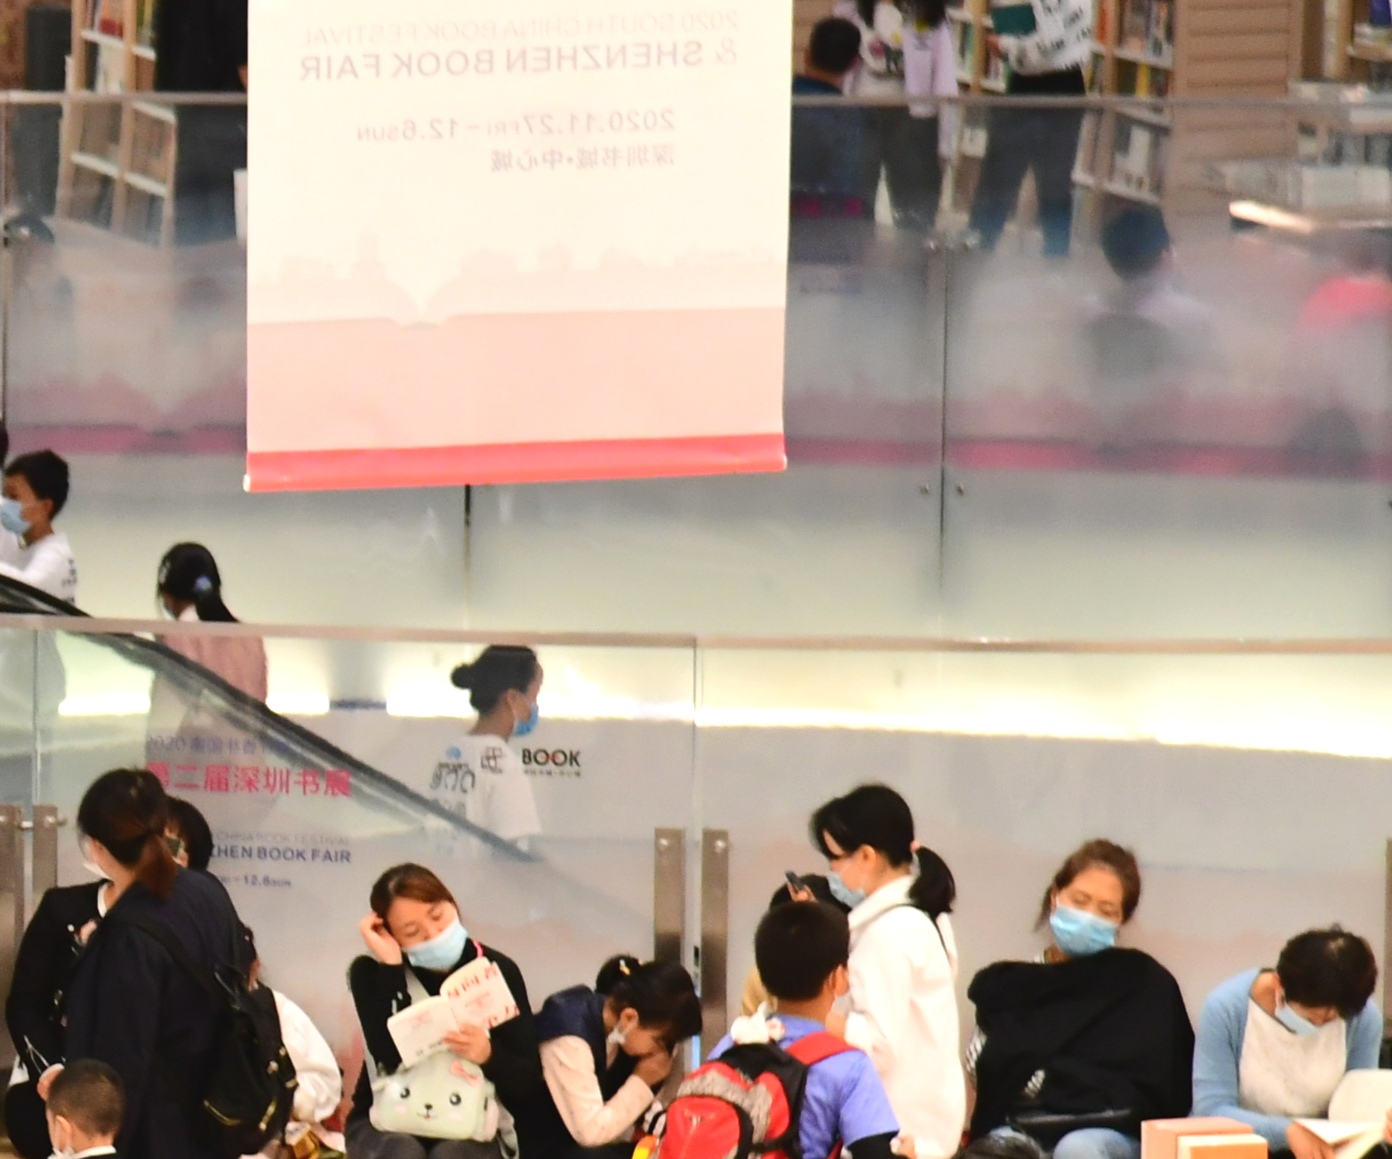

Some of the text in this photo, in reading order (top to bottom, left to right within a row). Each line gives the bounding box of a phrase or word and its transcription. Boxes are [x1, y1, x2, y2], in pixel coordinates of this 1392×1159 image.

[521, 748, 580, 767] BOOK
[257, 846, 306, 861] BOOK
[311, 849, 351, 863] FAIR
